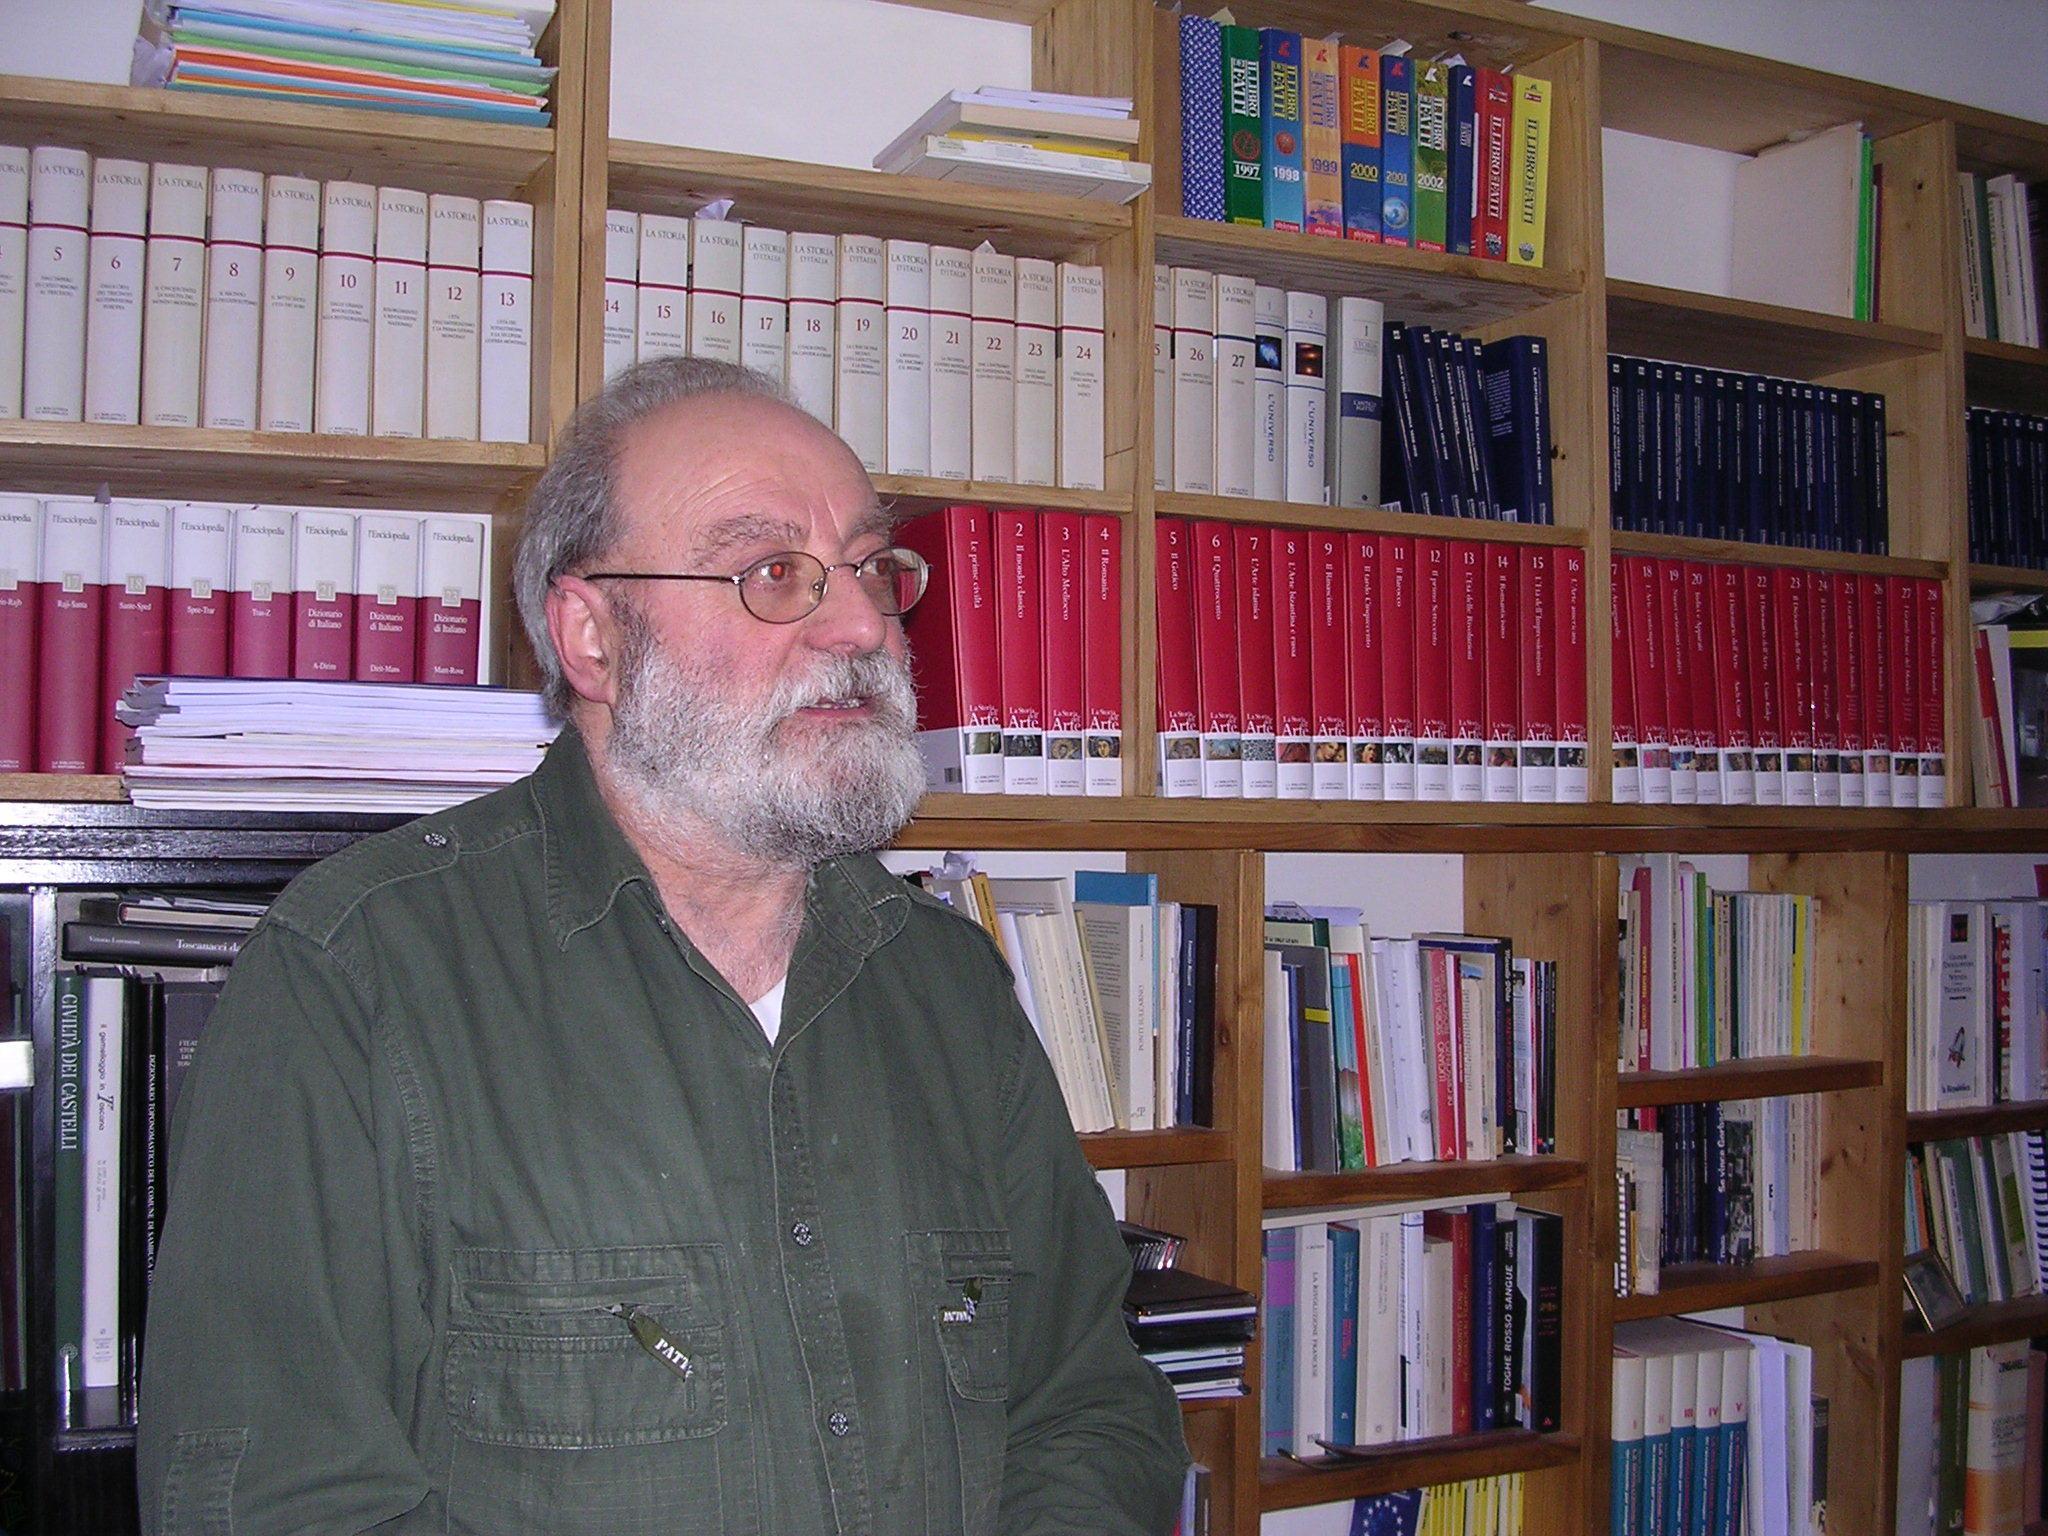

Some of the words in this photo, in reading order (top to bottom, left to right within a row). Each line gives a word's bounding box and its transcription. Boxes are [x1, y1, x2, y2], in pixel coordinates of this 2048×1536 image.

[1233, 67, 1246, 115] FATTI
[1248, 76, 1258, 118] LIBRO
[1273, 71, 1285, 118] FATTI
[1286, 81, 1296, 122] LIBRO
[1352, 86, 1365, 132] FATTI
[1367, 95, 1376, 135] LIBRO
[1420, 104, 1432, 147] FATTI
[1492, 116, 1502, 130] IL
[1527, 119, 1537, 133] IL
[1434, 112, 1442, 150] LIBRO
[1490, 132, 1502, 175] LIBRO
[1525, 135, 1537, 180] LIBRO
[39, 165, 50, 175] LA
[52, 166, 85, 178] STORIA
[1235, 164, 1259, 178] 1997
[1310, 158, 1338, 173] 1999
[1351, 164, 1378, 179] 2000
[1274, 166, 1299, 181] 1998
[1386, 172, 1407, 183] 2001
[1418, 175, 1444, 188] 2002
[1489, 182, 1501, 218] FATTI
[1523, 187, 1535, 225] FATTI
[382, 203, 393, 211] LA
[395, 204, 424, 215] STORIA
[487, 217, 498, 225] LA
[500, 217, 529, 229] STORIA
[700, 235, 711, 243] LA
[713, 236, 739, 248] STORIA
[53, 249, 62, 261] 5
[891, 254, 902, 263] LA
[903, 255, 928, 265] STORIA
[111, 256, 121, 269] 6
[172, 258, 183, 271] 7
[229, 263, 239, 276] 8
[286, 267, 295, 281] 9
[341, 274, 357, 288] 10
[395, 281, 408, 294] 11
[448, 286, 462, 300] 12
[500, 292, 515, 306] 13
[657, 305, 671, 318] 15
[712, 311, 725, 324] 16
[1309, 309, 1313, 319] 2
[760, 317, 773, 330] 17
[807, 319, 820, 332] 18
[856, 318, 870, 331] 19
[901, 327, 918, 340] 20
[946, 331, 959, 344] 21
[986, 337, 1001, 350] 22
[1028, 343, 1043, 356] 23
[1076, 346, 1091, 359] 24
[1190, 348, 1204, 361] 26
[1232, 354, 1244, 367] 27
[1267, 393, 1275, 462] L'UNIVERSO
[970, 518, 975, 532] 1
[1015, 522, 1024, 537] 2
[1061, 526, 1070, 541] 3
[1100, 527, 1110, 540] 4
[1170, 531, 1177, 545] 5
[970, 540, 979, 552] Le
[1212, 534, 1221, 548] 6
[1250, 536, 1259, 550] 7
[1287, 541, 1296, 554] 8
[1324, 542, 1333, 556] 9
[1361, 545, 1373, 558] 10
[1395, 547, 1404, 560] 11
[1430, 550, 1441, 562] 12
[1061, 548, 1070, 577] L'Alto
[1464, 552, 1475, 564] 13
[1498, 555, 1509, 568] 14
[1533, 557, 1544, 569] 15
[968, 554, 979, 580] prime
[1016, 553, 1026, 584] mondo
[1251, 558, 1259, 585] L'Arte
[1568, 559, 1580, 572] 16
[1101, 557, 1110, 600] Romanico
[1171, 561, 1179, 590] Gotico
[1288, 562, 1296, 589] L'Arte
[1213, 563, 1222, 620] Quattrocento
[1325, 571, 1334, 626] Rinascimento
[1017, 586, 1026, 618] classico
[1062, 578, 1070, 621] Medioevo
[308, 608, 343, 619] Dizionario
[370, 611, 404, 622] Dizionario
[434, 613, 468, 624] Dizionario
[308, 619, 316, 629] di
[317, 619, 342, 629] Italiano
[370, 622, 377, 632] di
[378, 623, 403, 633] Italiano
[434, 624, 441, 634] di
[442, 625, 467, 634] Italiano
[969, 712, 999, 726] Arte
[1091, 716, 1119, 730] Arte
[176, 939, 227, 952] Toscanacci
[1434, 976, 1442, 1002] DELLA
[61, 993, 82, 1045] CIVILTÀ
[1435, 1004, 1443, 1035] STORIA
[61, 1055, 77, 1078] DEI
[1437, 1041, 1446, 1082] LUCIANO
[148, 1054, 157, 1101] DIZIONARIO
[61, 1083, 77, 1151] CASTELLI
[97, 1093, 115, 1130] Toscana
[148, 1103, 156, 1167] TOPONOMASTICO
[1718, 1150, 1726, 1177] vince
[147, 1169, 155, 1184] DEL
[1718, 1179, 1726, 1193] Se
[147, 1186, 155, 1219] COMUNE
[147, 1221, 155, 1229] DI
[147, 1230, 155, 1268] SAMBUCA
[1312, 1272, 1318, 1282] LA
[1504, 1265, 1513, 1310] SANGUE
[1504, 1314, 1512, 1351] ROSSO
[1503, 1355, 1512, 1392] TOGHE
[1684, 1409, 1693, 1418] III
[1709, 1407, 1718, 1417] IV
[1736, 1403, 1742, 1412] V
